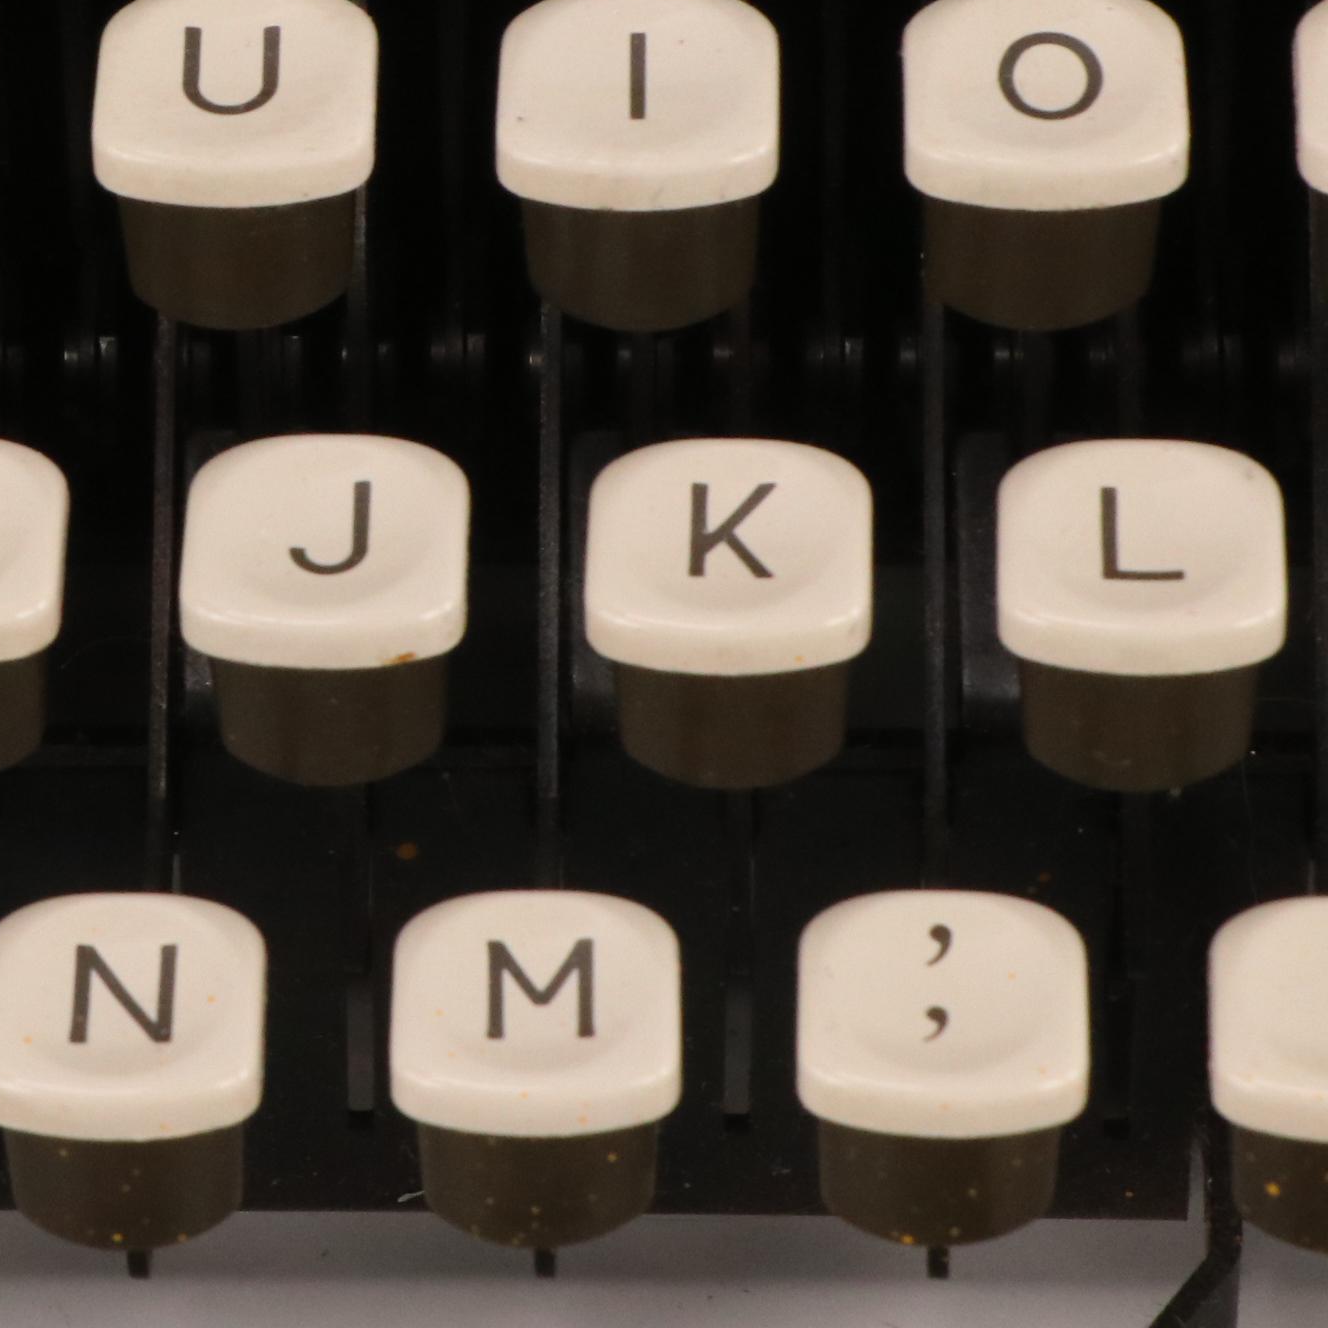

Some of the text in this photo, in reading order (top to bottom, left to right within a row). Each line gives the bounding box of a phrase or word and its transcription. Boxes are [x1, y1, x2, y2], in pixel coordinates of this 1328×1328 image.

[182, 25, 281, 116] U
[629, 32, 646, 120] I
[997, 31, 1104, 121] O
[289, 480, 371, 576] J
[688, 482, 776, 579] K
[1100, 487, 1185, 582] L
[68, 944, 177, 1044] N
[486, 939, 595, 1040] M
